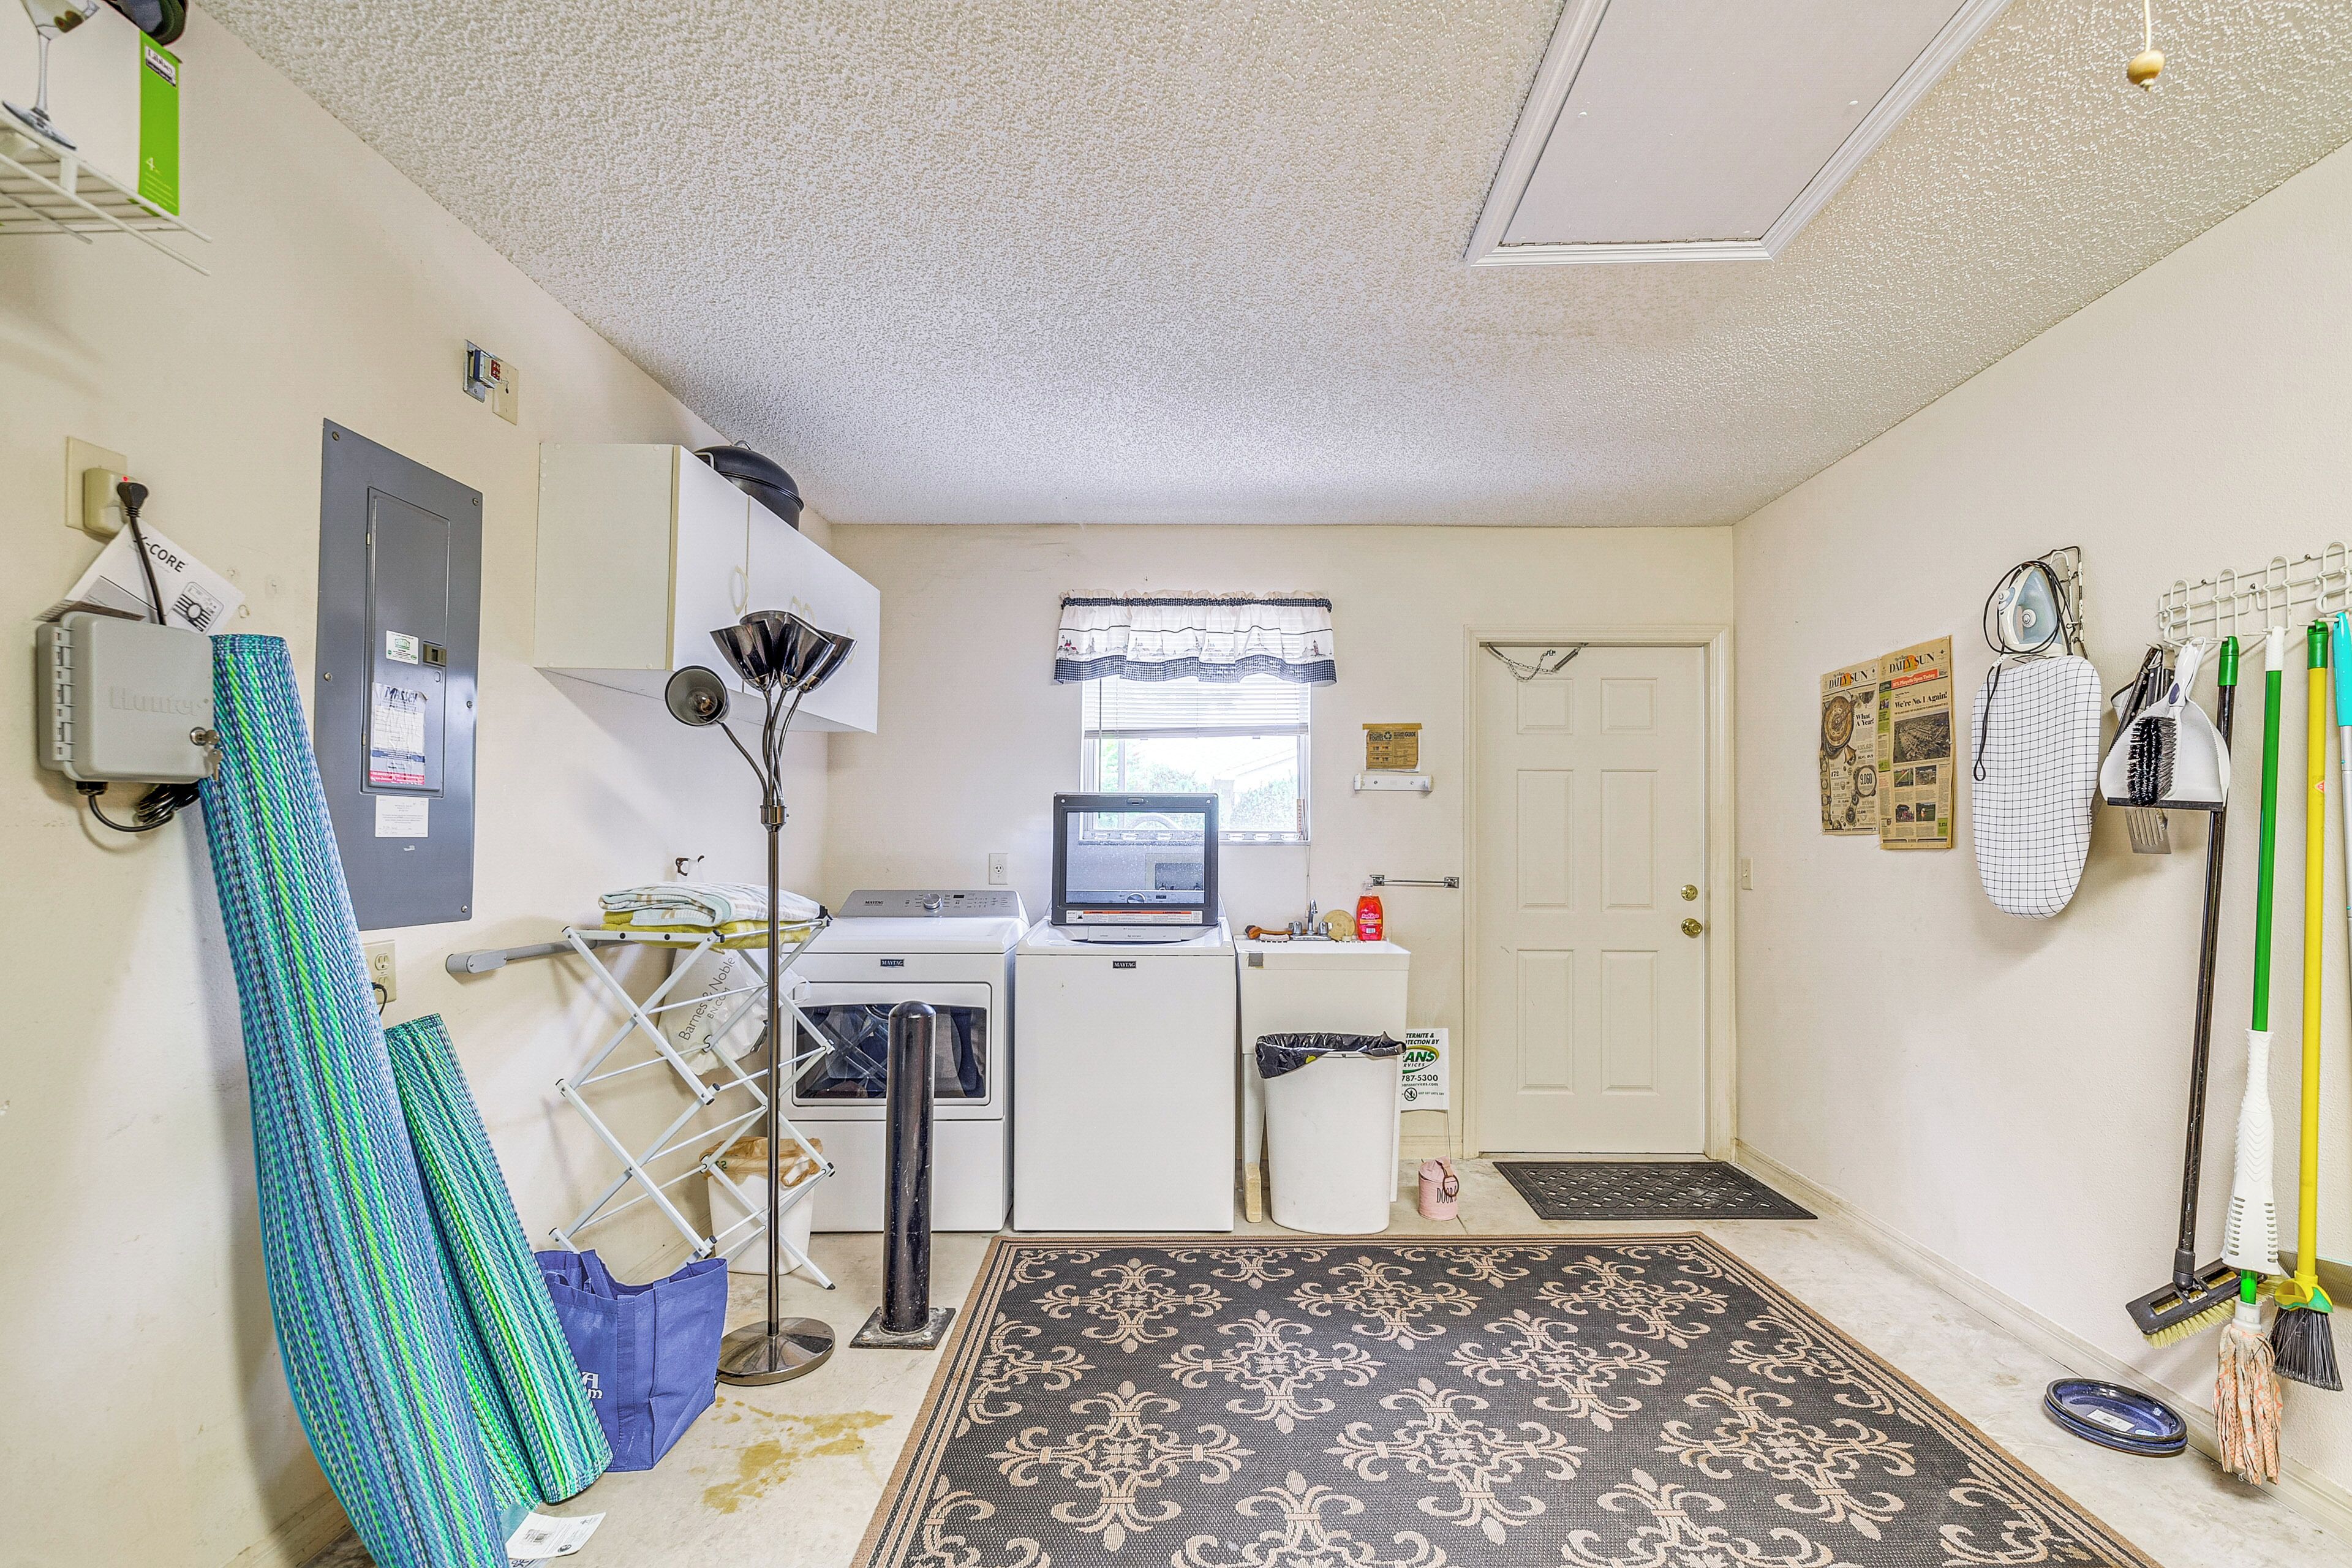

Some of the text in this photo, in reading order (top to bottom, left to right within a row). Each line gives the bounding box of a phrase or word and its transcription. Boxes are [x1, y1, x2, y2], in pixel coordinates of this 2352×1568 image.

[146, 157, 156, 171] 4
[1890, 658, 1912, 673] DAILY
[1915, 652, 1934, 666] SUN
[1829, 676, 1847, 689] DAILY
[1850, 670, 1869, 682] SUN
[1927, 692, 1948, 703] Again!
[678, 1002, 708, 1041] Barnes
[708, 957, 736, 991] Noble
